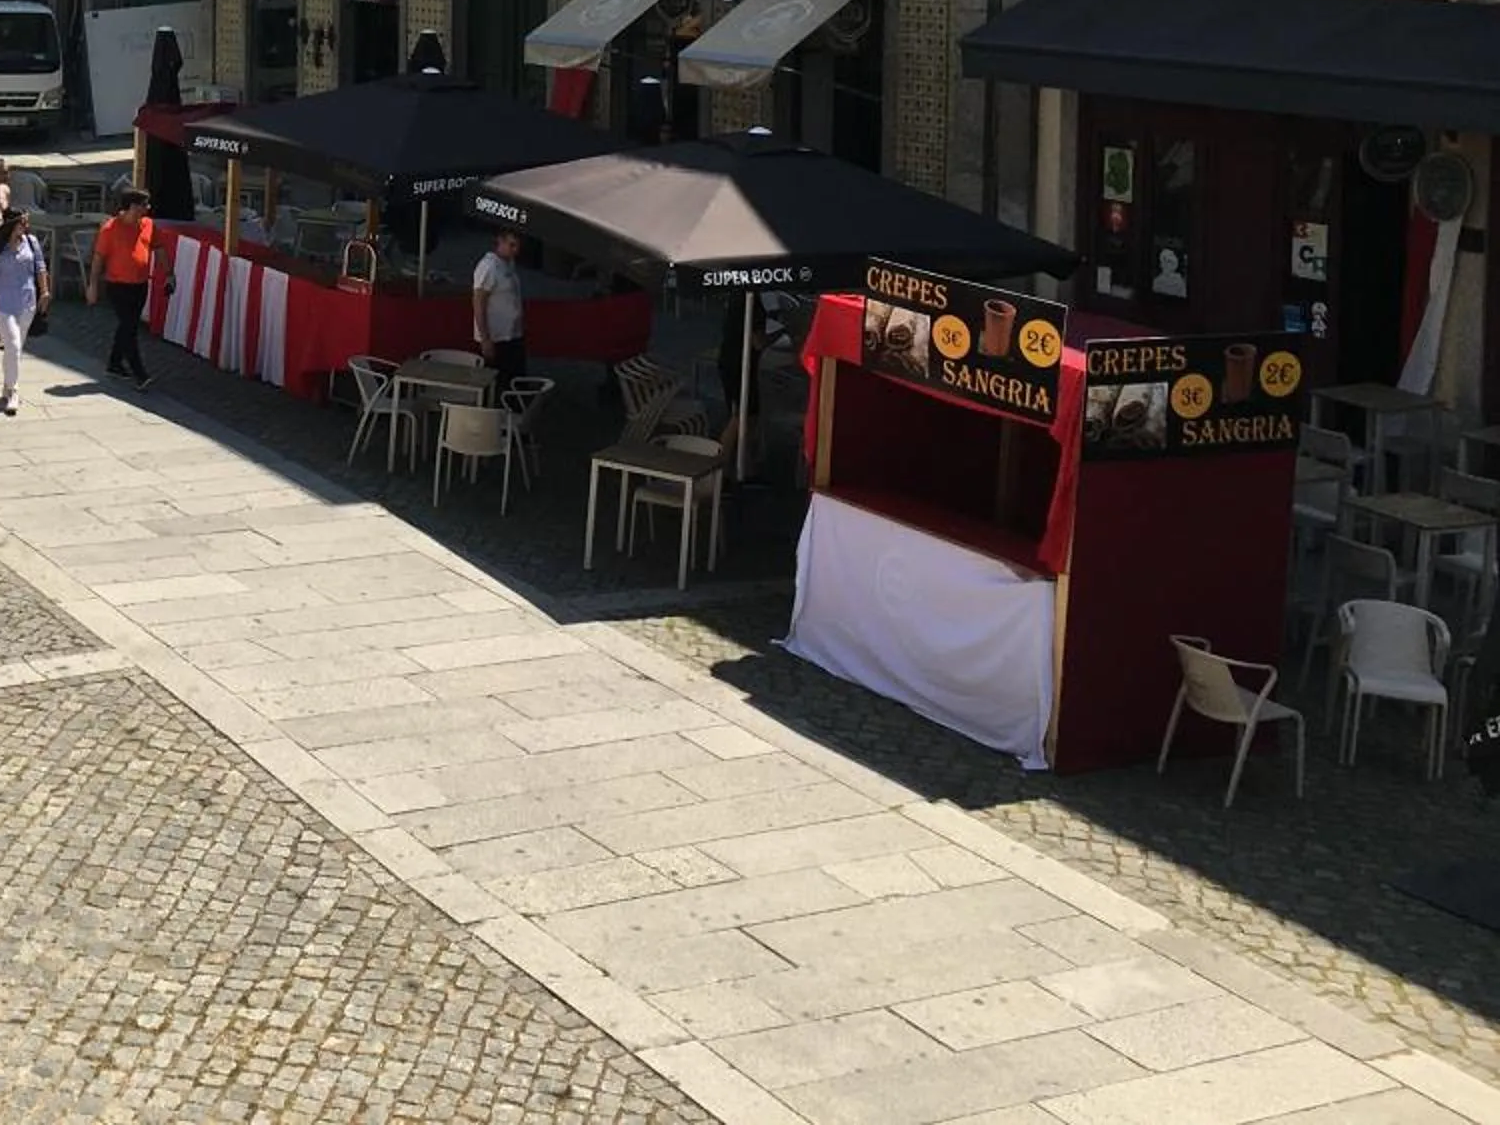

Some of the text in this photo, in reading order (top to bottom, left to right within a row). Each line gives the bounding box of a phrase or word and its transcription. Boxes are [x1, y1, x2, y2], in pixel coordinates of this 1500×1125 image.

[702, 266, 794, 286] SUPER BOCK
[867, 266, 949, 309] CREPES
[940, 327, 1057, 357] 3€ 2€
[1087, 345, 1188, 375] CREPES
[942, 360, 1053, 415] SANGRIA
[1180, 362, 1295, 407] 3€ 2€
[1181, 414, 1295, 445] SANGRIA
